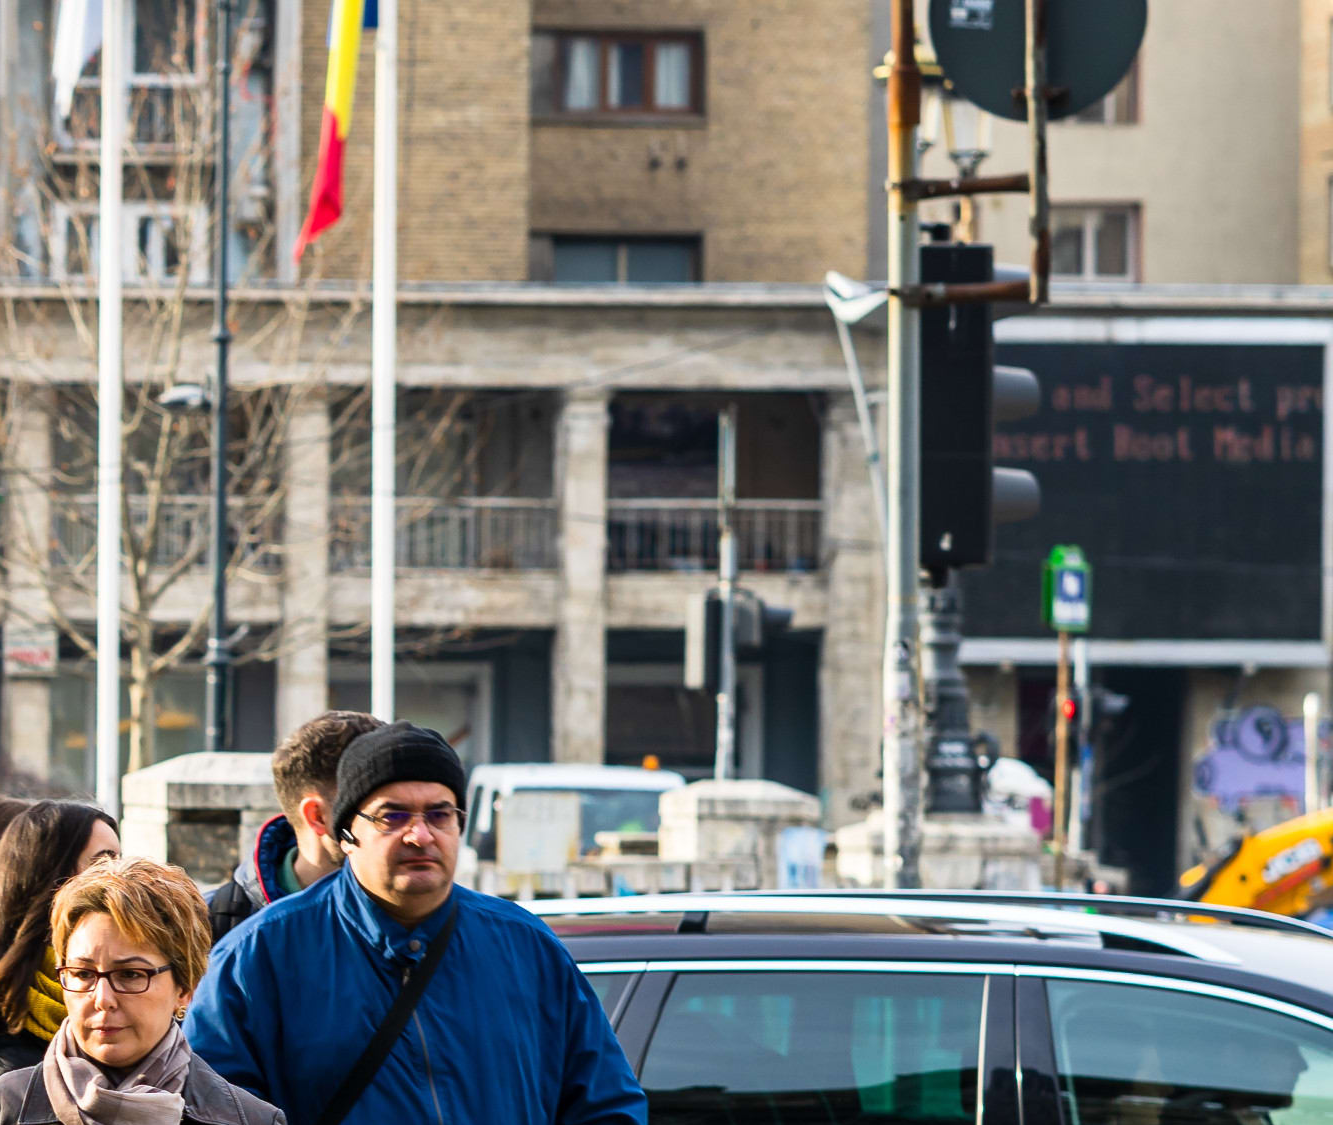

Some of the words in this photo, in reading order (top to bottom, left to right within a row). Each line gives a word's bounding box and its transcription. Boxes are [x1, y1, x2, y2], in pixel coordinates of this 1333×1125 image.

[1133, 374, 1254, 413] Select
[993, 425, 1090, 461] nsert
[1113, 424, 1192, 462] Boot
[1213, 424, 1316, 462] Media
